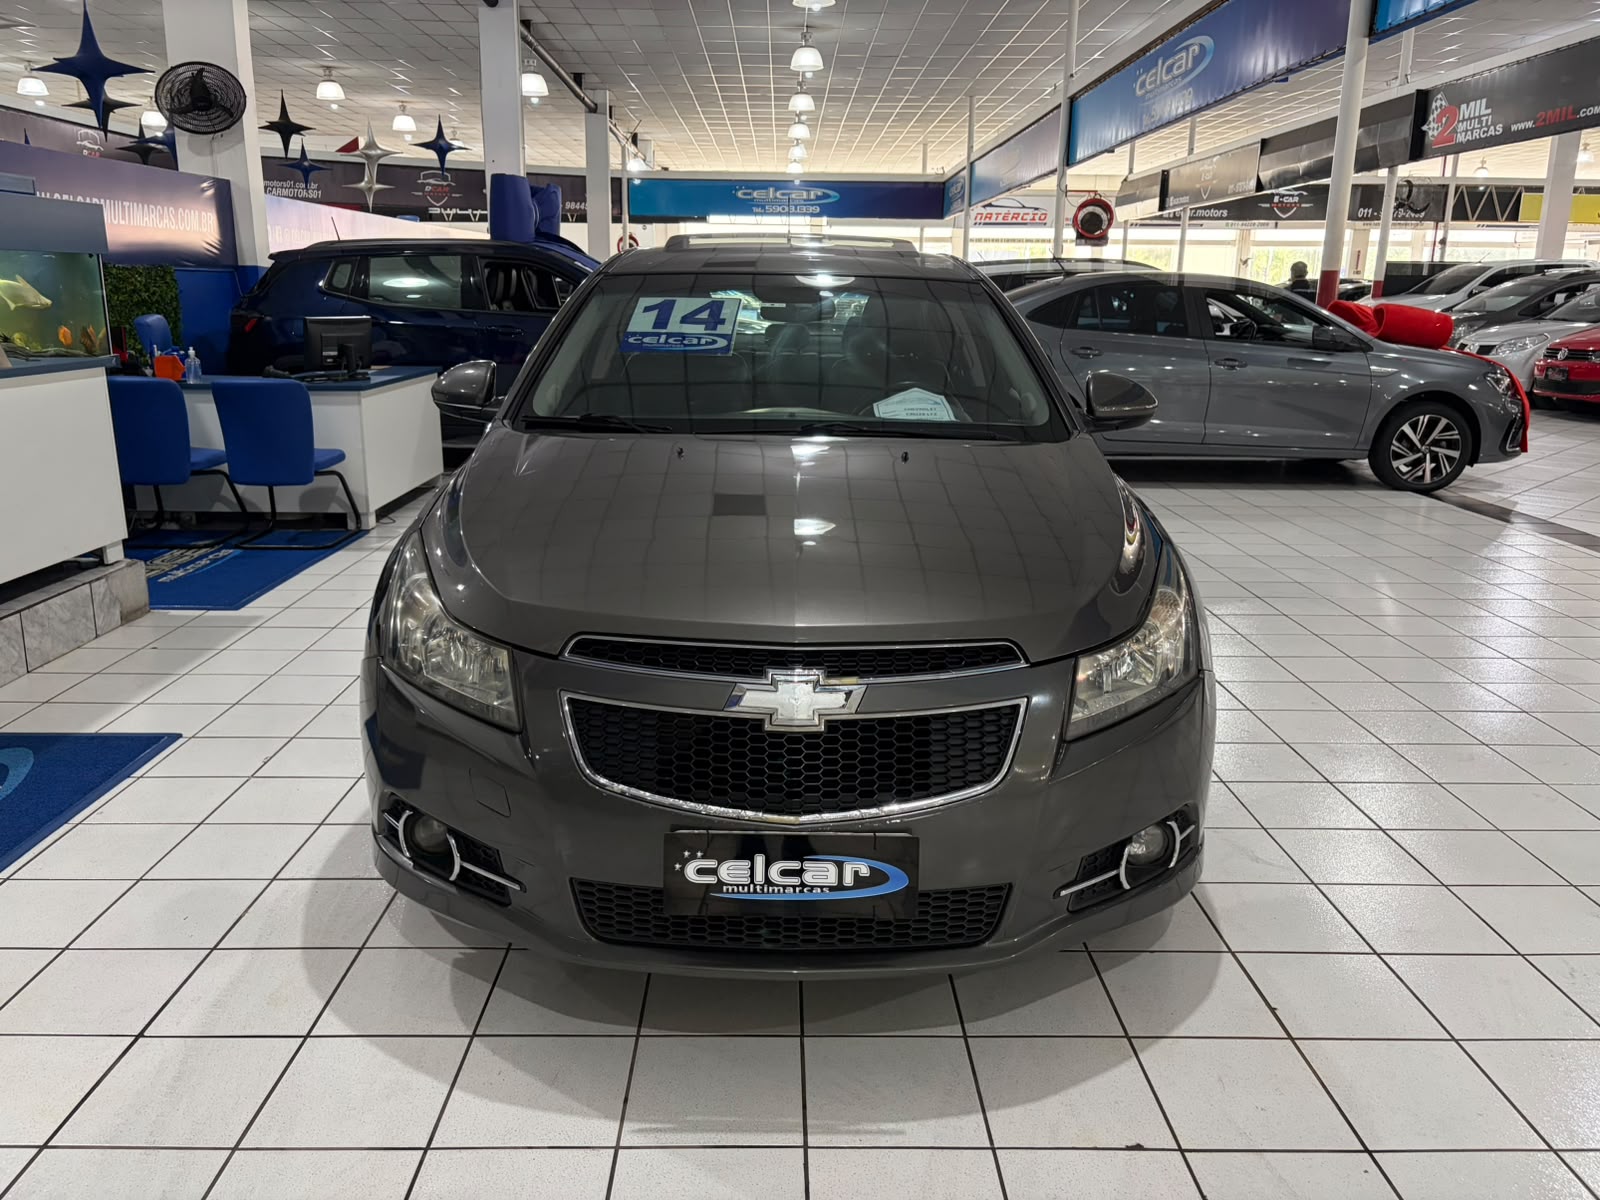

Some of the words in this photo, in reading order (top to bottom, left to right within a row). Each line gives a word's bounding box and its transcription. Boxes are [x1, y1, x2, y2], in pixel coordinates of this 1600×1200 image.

[1135, 42, 1200, 97] celcar
[1459, 98, 1492, 120] MIL
[1457, 115, 1492, 132] MULTI
[1456, 124, 1503, 144] MARCAS
[264, 180, 319, 190] motors01.co.br
[737, 187, 824, 199] celcar
[1174, 208, 1229, 218] er.motors
[642, 299, 727, 331] 14
[627, 335, 713, 345] celcar
[683, 853, 871, 886] celcar
[722, 883, 830, 894] multimarcas
